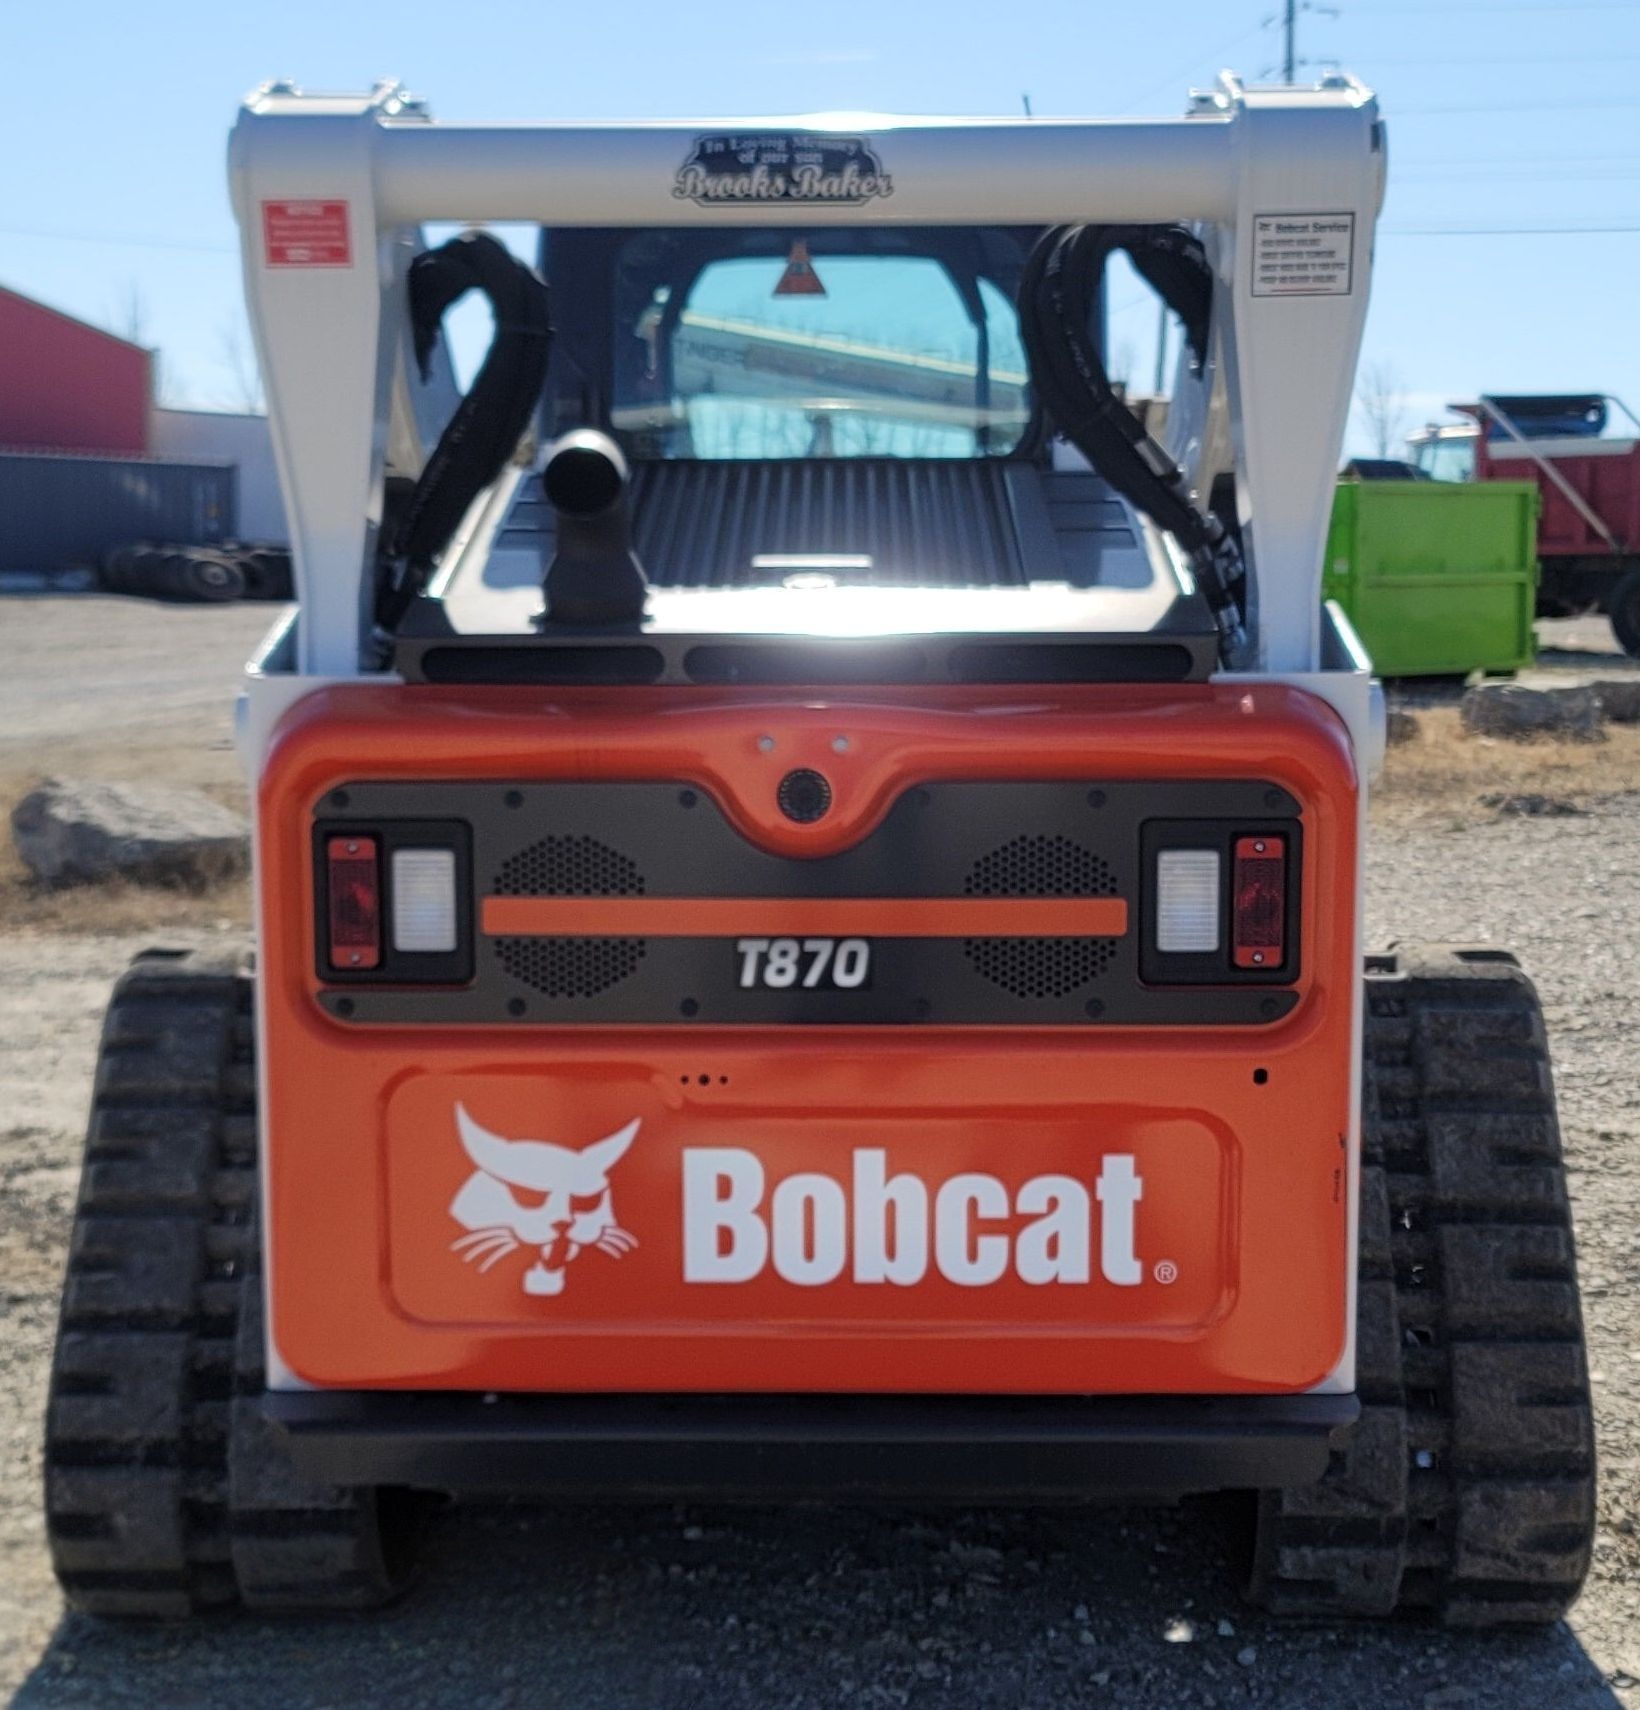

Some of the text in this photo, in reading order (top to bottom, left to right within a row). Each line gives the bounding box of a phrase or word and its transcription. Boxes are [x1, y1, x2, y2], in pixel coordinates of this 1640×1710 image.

[706, 140, 726, 153] In
[730, 137, 787, 152] Loving
[738, 149, 757, 164] of
[672, 160, 895, 200] Brooks Baker
[1312, 221, 1350, 233] Service
[737, 939, 870, 988] T870
[682, 1147, 1143, 1287] Bobcat
